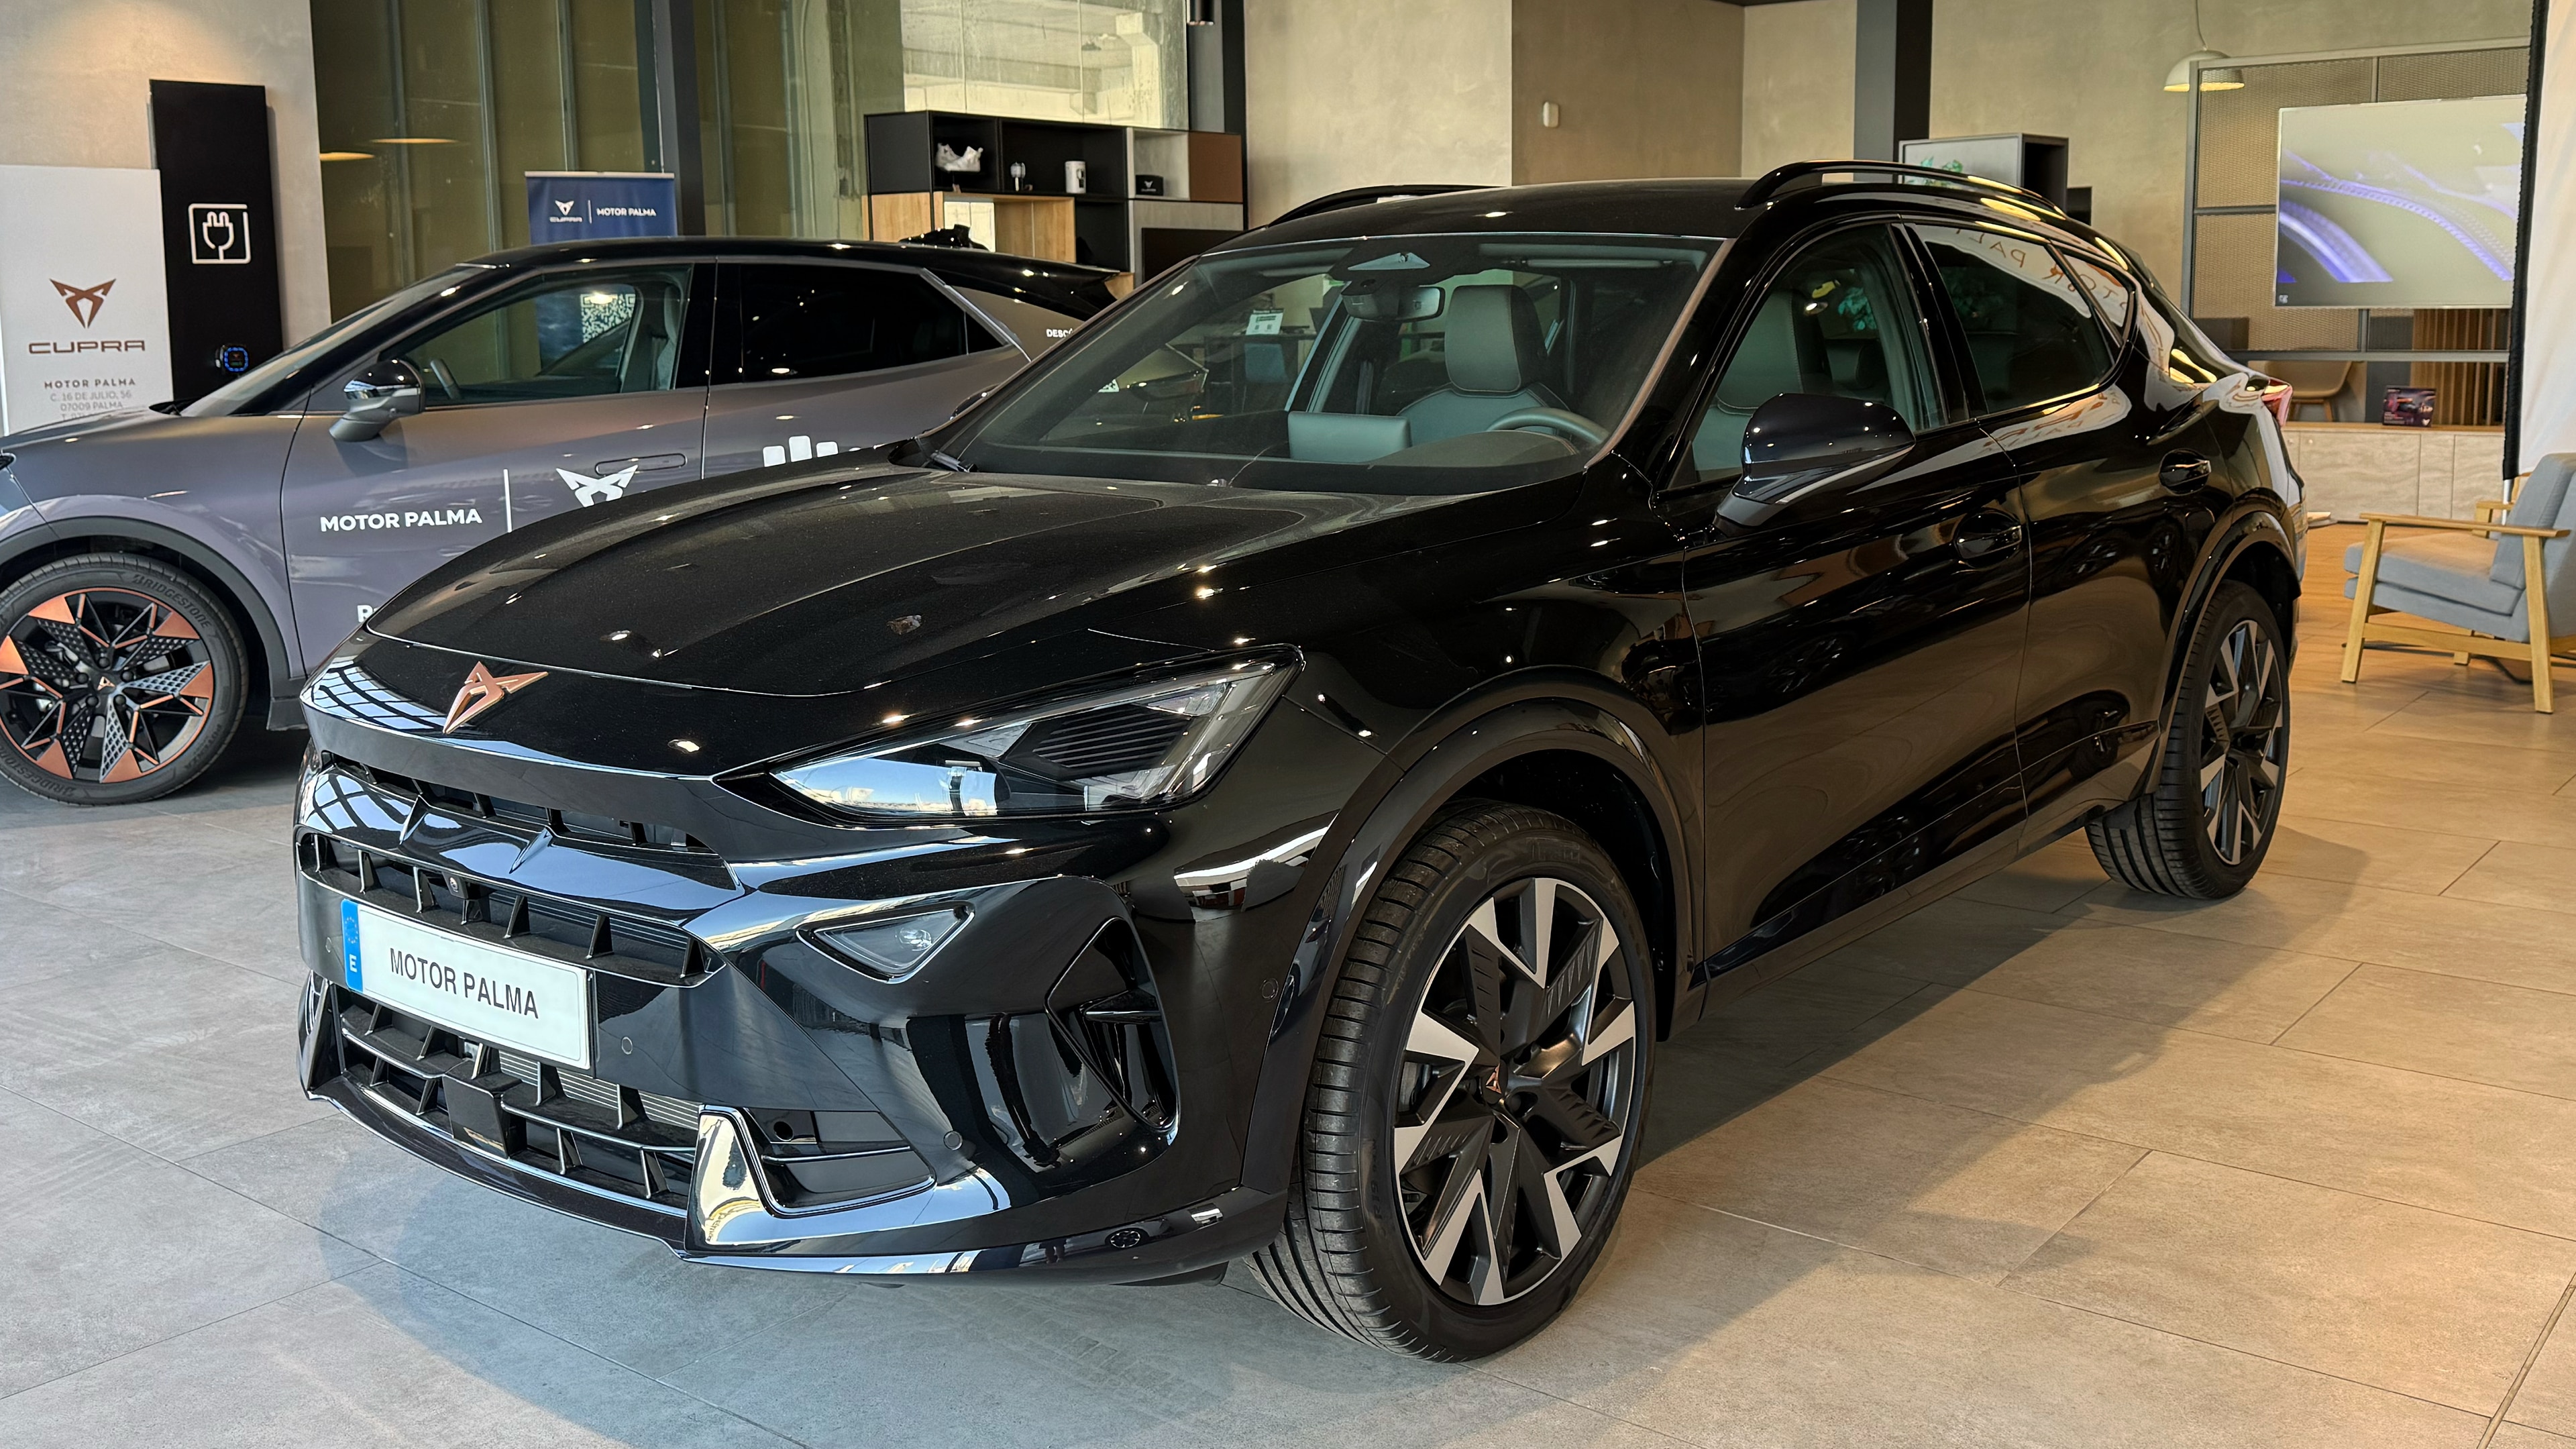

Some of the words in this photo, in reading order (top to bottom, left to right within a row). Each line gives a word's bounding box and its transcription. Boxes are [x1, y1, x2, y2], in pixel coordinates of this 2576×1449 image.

[596, 207, 627, 216] MOTOR
[628, 208, 657, 217] PALMA
[29, 340, 145, 354] CUPRA
[44, 380, 89, 389] MOTOR
[95, 378, 136, 387] PALMA
[75, 392, 87, 400] DE
[93, 401, 123, 410] PALMA
[321, 513, 400, 532] MOTOR
[405, 508, 483, 527] PALMA
[132, 574, 213, 629] BRIDGESTONE
[350, 954, 358, 973] E
[390, 947, 457, 995] MOTOR
[463, 971, 539, 1019] PALMA
